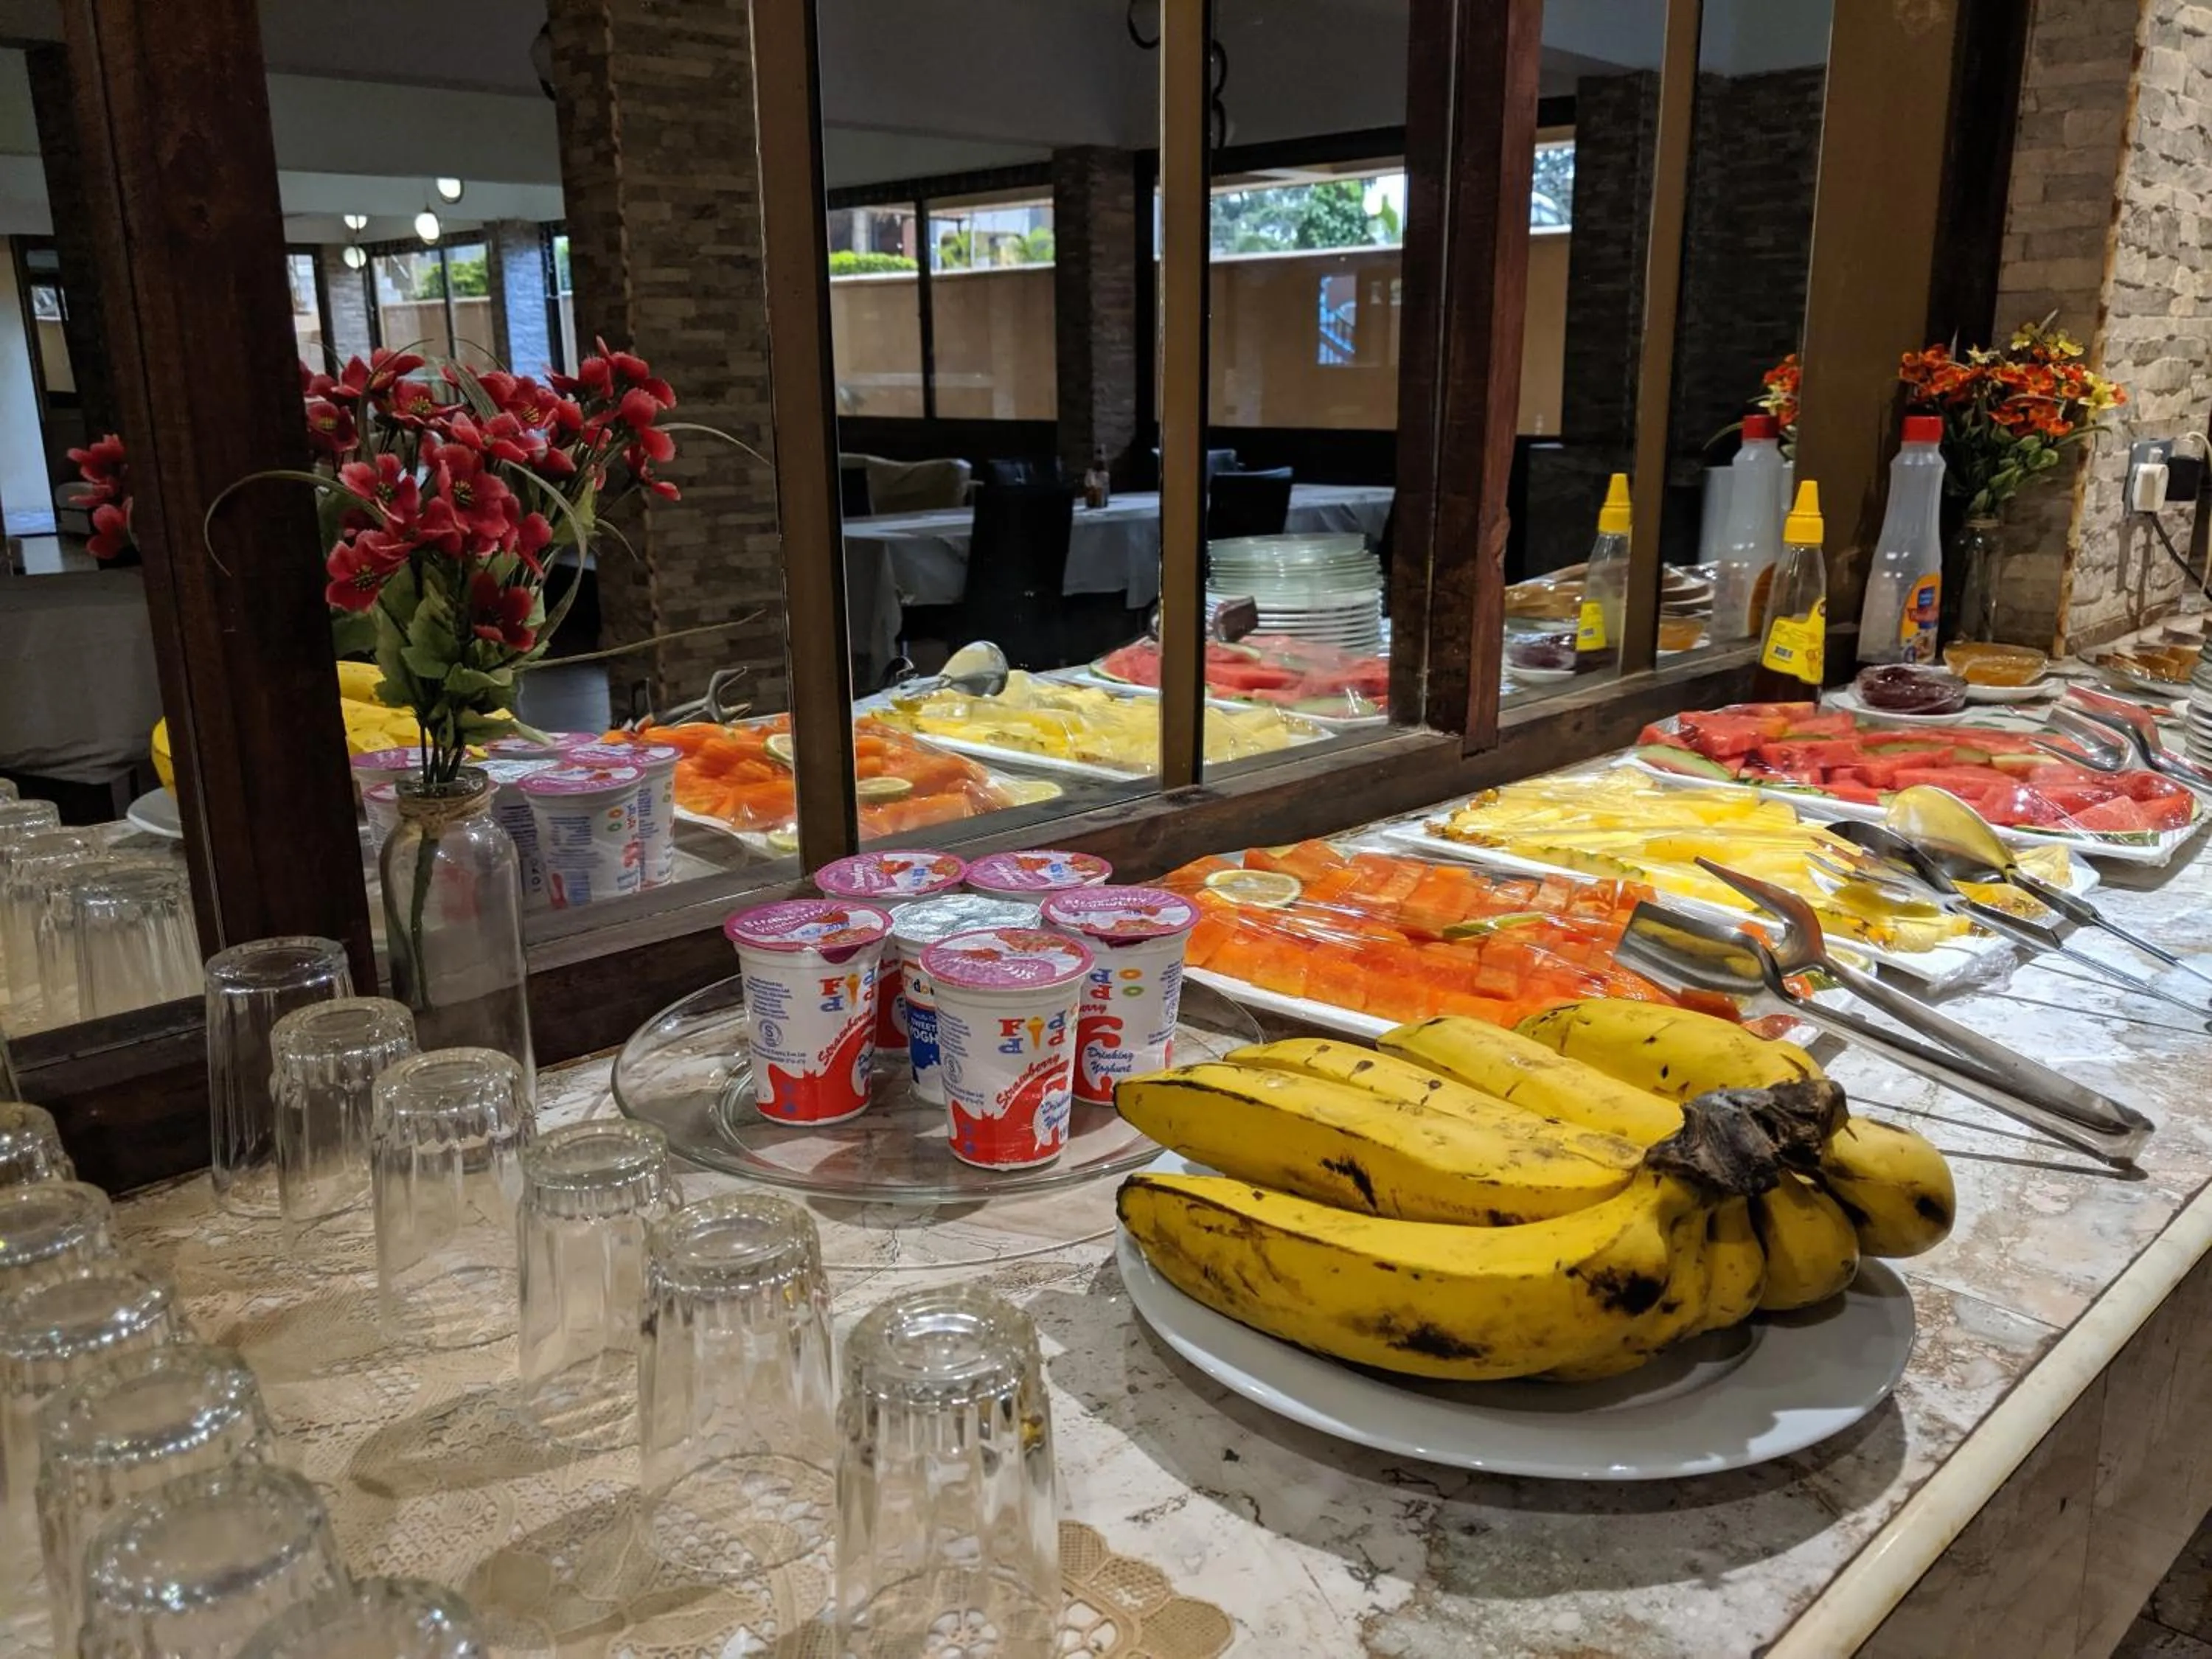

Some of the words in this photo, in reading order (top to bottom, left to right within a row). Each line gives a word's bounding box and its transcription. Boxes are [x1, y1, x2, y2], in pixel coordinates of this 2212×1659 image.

[1087, 1046, 1135, 1062] Drinking
[1090, 1060, 1133, 1075] Yoghurt
[996, 1053, 1061, 1110] Strawberry
